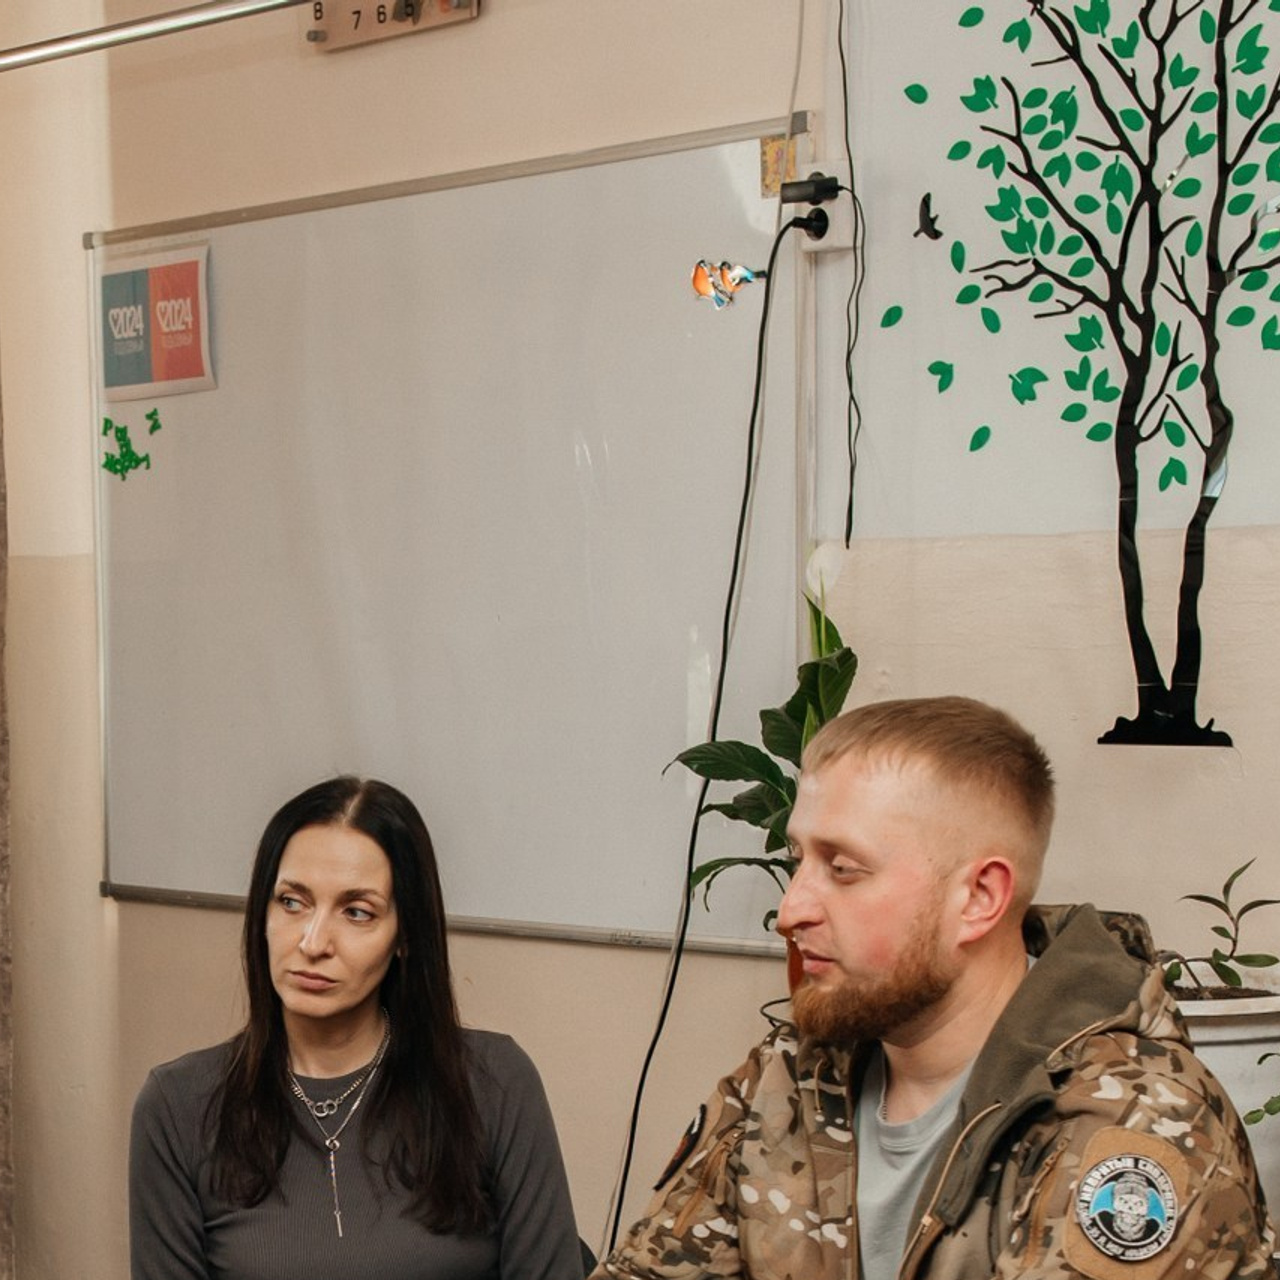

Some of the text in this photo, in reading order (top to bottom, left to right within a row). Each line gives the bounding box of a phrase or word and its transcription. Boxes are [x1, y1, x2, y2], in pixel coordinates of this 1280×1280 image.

[313, 1, 323, 21] 8
[351, 10, 362, 30] 7
[376, 4, 387, 24] 6
